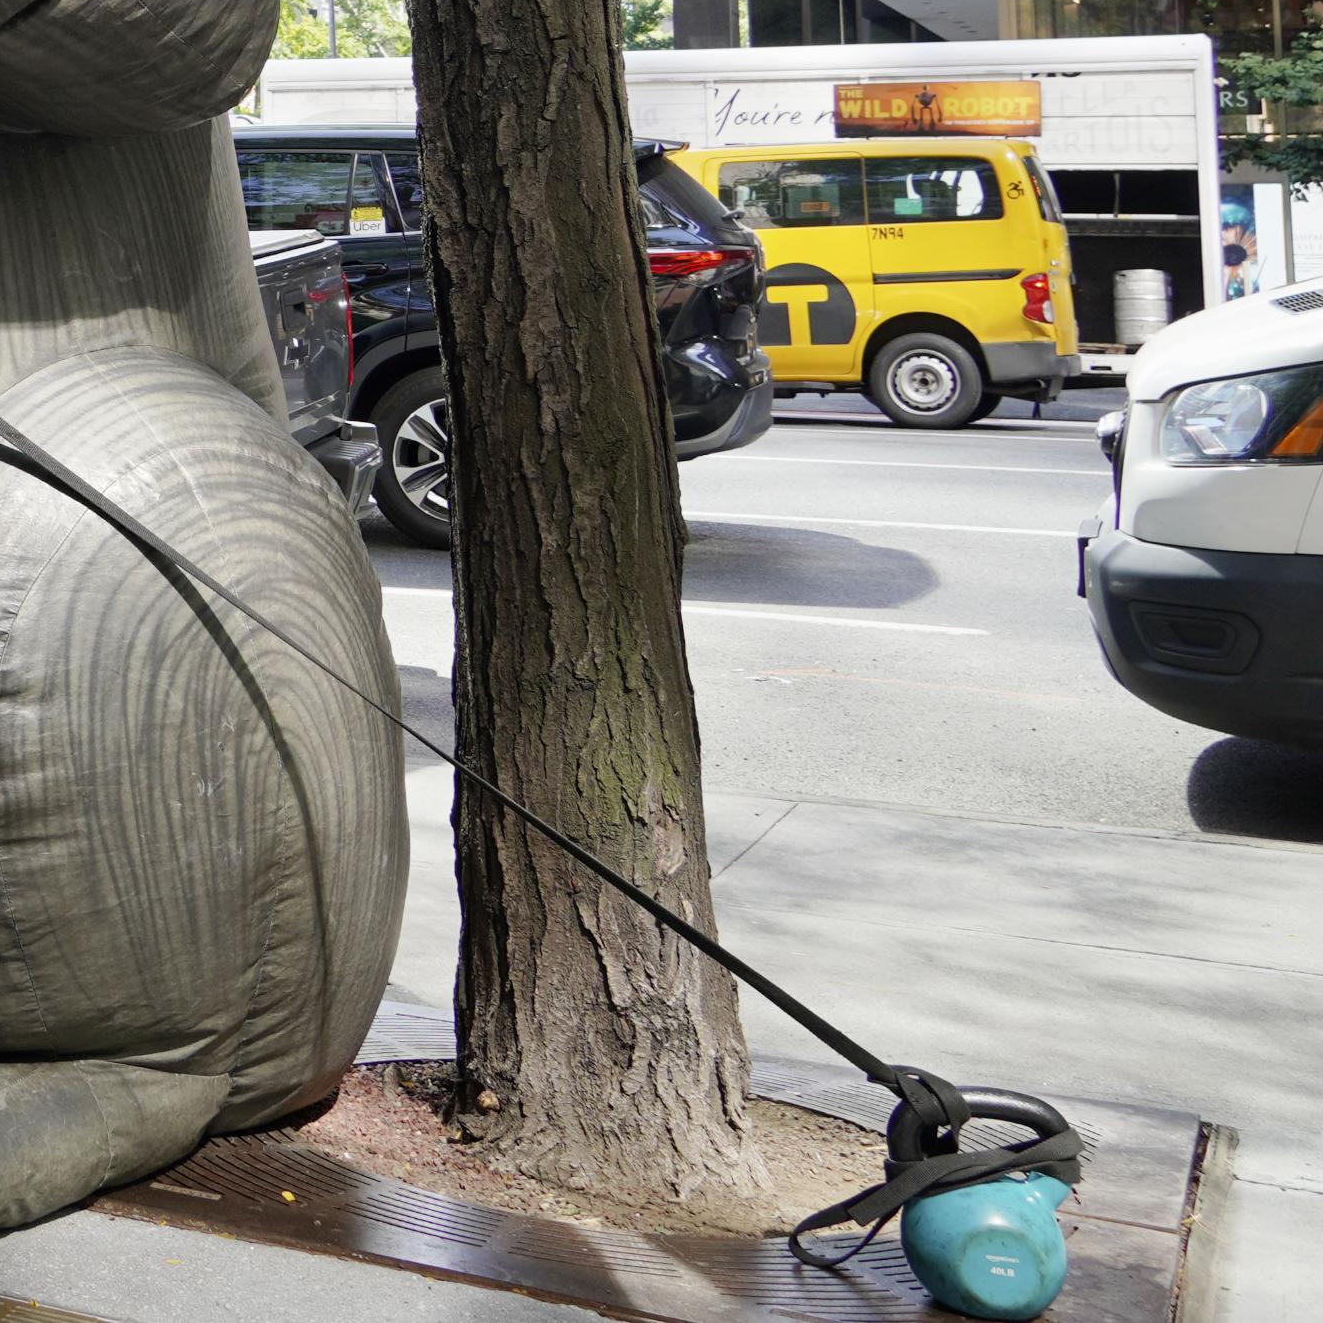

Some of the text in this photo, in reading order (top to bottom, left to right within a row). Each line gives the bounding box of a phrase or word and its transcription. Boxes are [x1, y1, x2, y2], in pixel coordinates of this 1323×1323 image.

[839, 90, 863, 98] THE
[839, 96, 1034, 119] WILD ROBOT
[353, 221, 380, 231] Uber
[872, 228, 904, 240] 7N94
[766, 283, 829, 346] T
